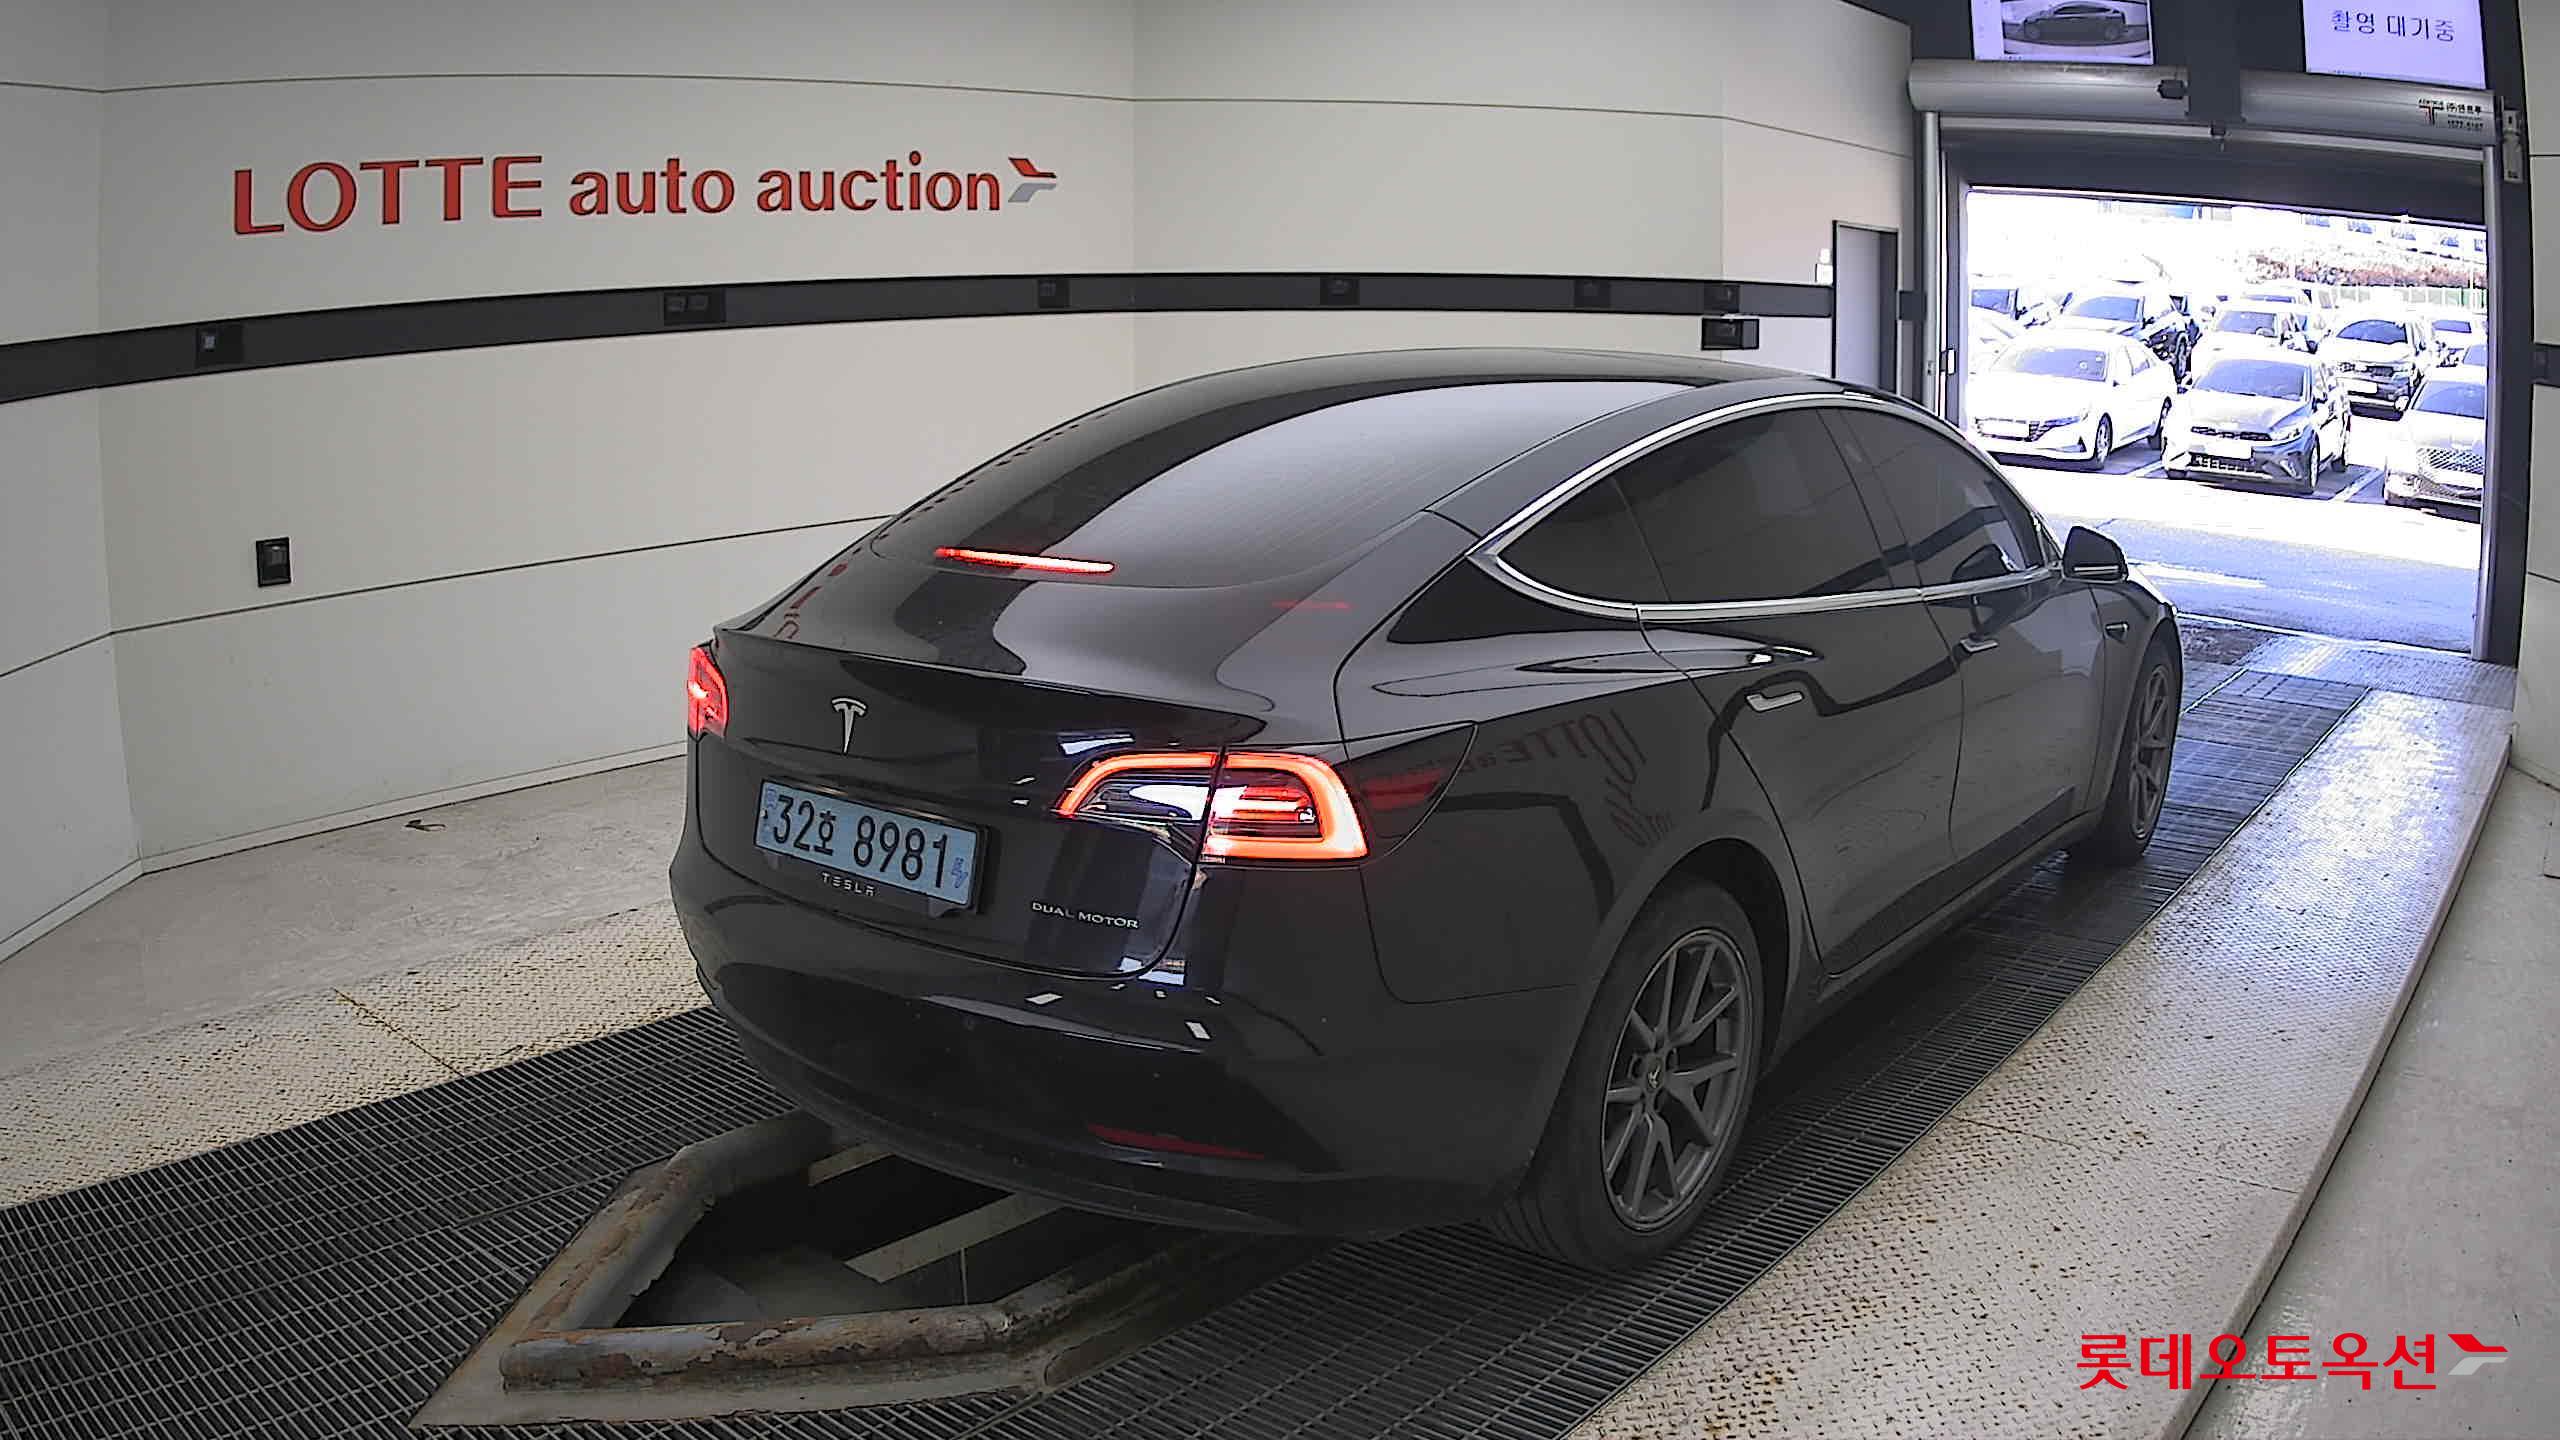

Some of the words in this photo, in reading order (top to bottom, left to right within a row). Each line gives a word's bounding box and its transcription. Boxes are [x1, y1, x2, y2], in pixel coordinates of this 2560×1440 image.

[2331, 10, 2376, 35] 촬영
[2386, 15, 2456, 43] 대기중
[234, 155, 543, 235] LOTTE
[569, 157, 737, 215] auto
[757, 150, 1001, 213] auction
[773, 794, 836, 857] 32호
[853, 815, 948, 889] 8981
[821, 871, 876, 897] TESLA
[1032, 902, 1075, 919] DUAL
[1078, 911, 1140, 929] MOTOR
